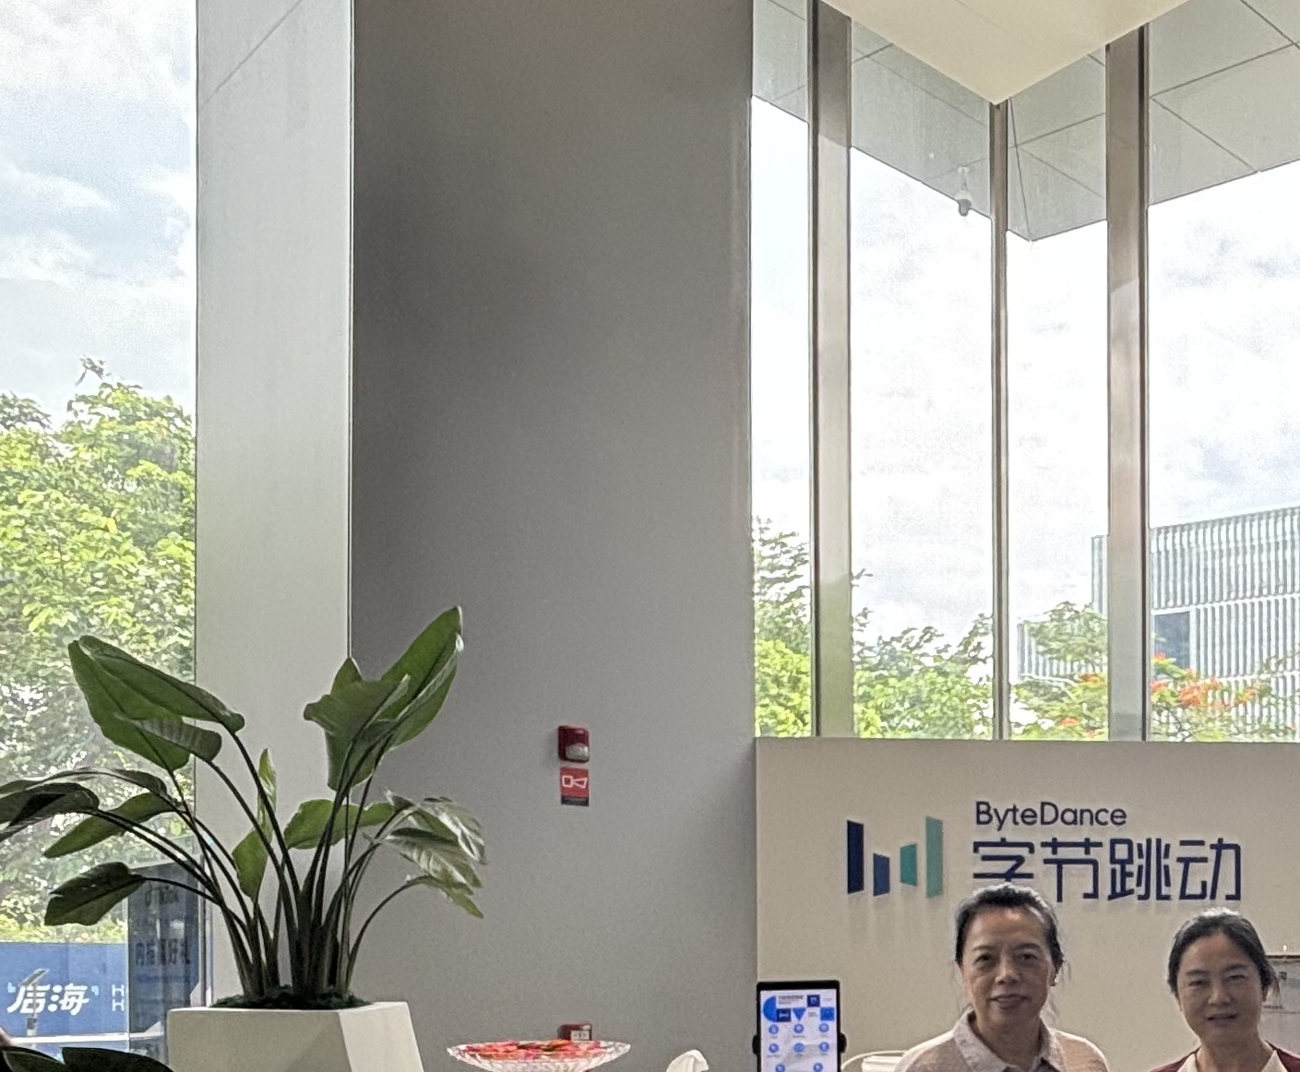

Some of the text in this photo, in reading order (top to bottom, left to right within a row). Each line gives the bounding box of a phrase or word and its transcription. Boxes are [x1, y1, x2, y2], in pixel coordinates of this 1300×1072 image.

[975, 801, 1128, 831] ByteDance
[973, 838, 1241, 902] 字节跳动
